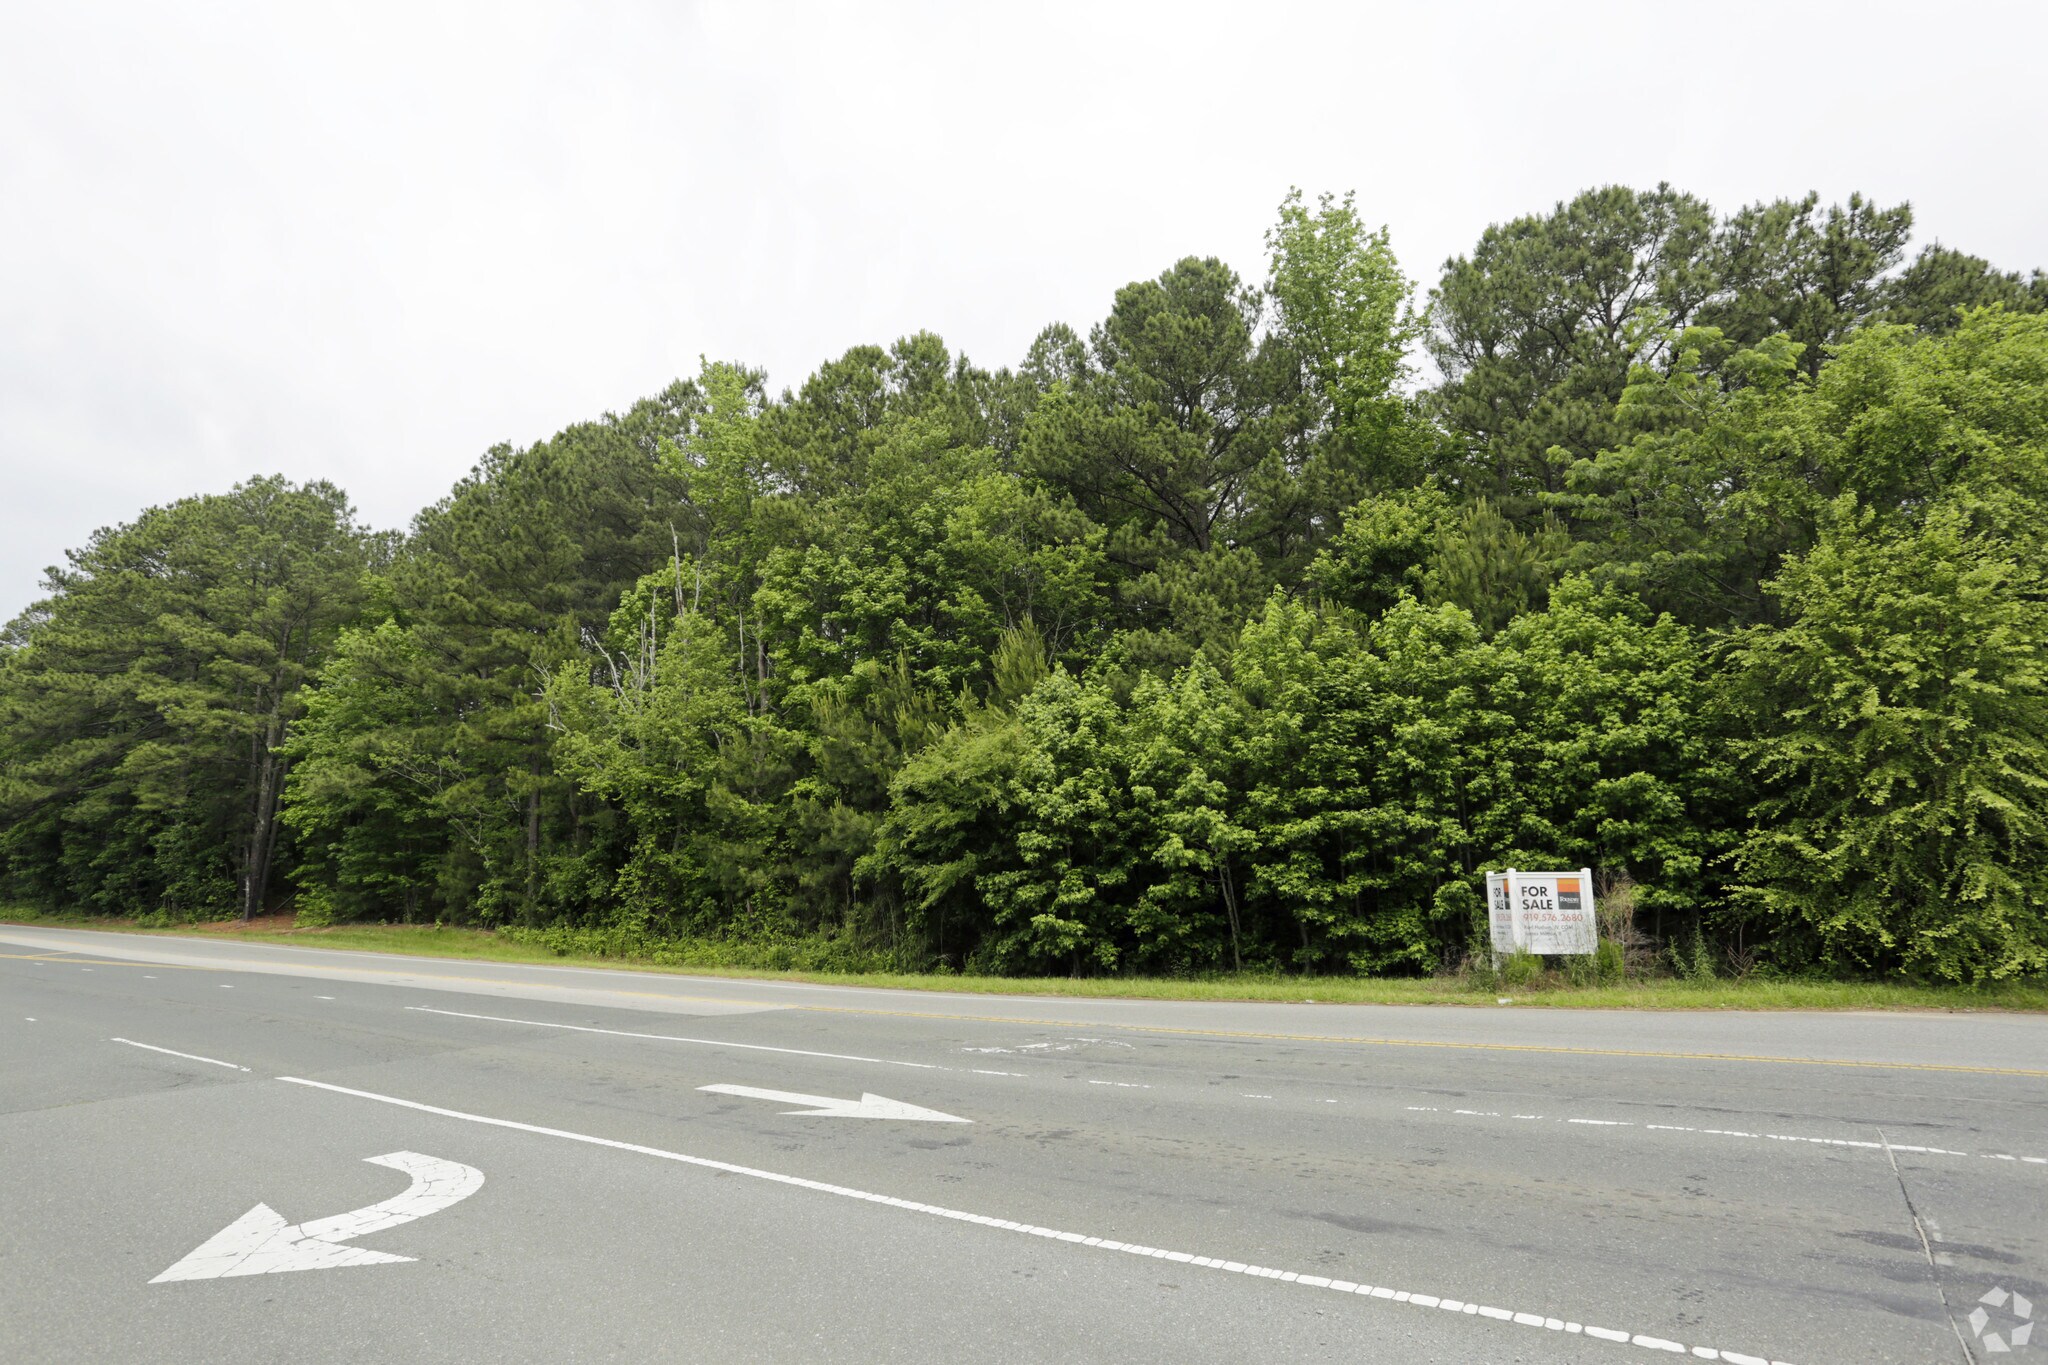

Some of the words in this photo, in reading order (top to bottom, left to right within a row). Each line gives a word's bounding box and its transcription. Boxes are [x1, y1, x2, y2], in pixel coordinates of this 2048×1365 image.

[1494, 887, 1502, 898] FOR
[1521, 886, 1548, 897] FOR
[1495, 900, 1505, 910] SALE
[1522, 899, 1553, 910] SALE
[1522, 913, 1584, 922] 919.576.2680
